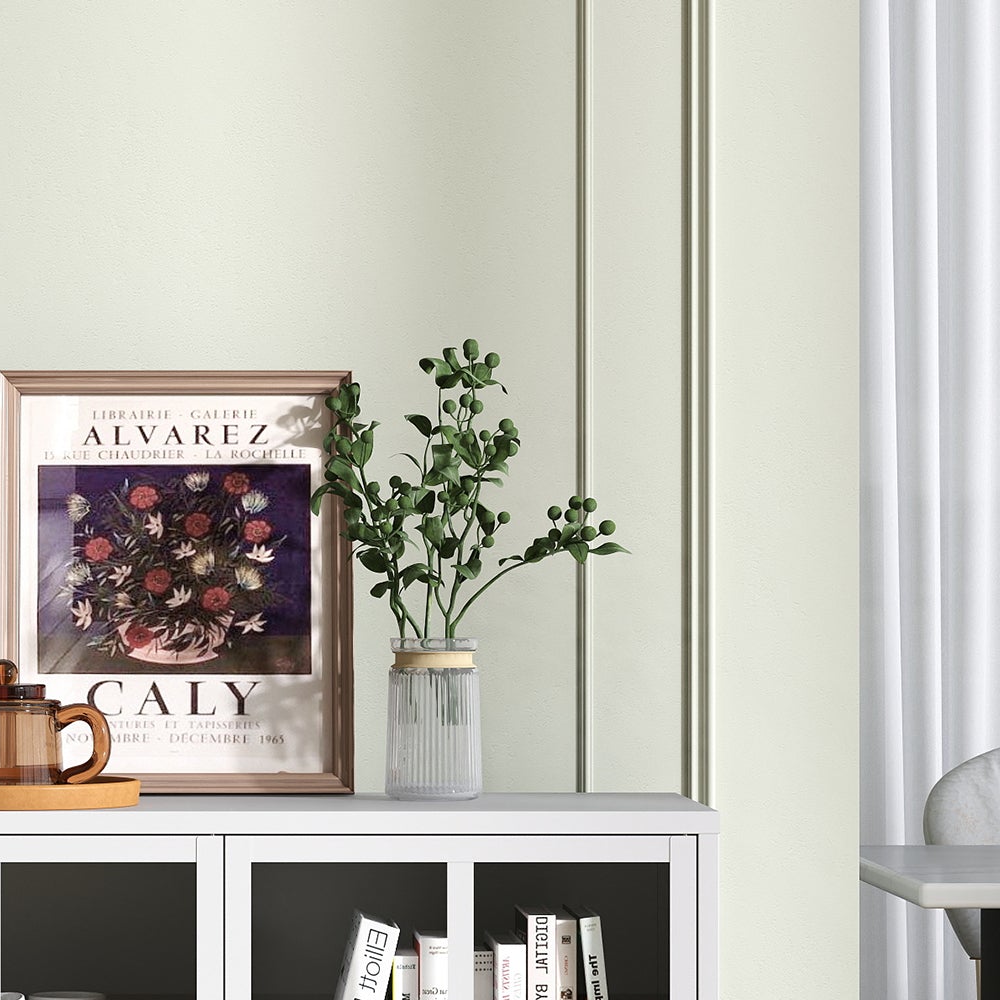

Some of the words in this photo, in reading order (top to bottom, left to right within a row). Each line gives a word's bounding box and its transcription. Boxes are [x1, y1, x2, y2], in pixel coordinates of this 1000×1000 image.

[92, 410, 172, 420] LIBRAIRIE
[191, 410, 258, 420] GALERIE
[82, 424, 269, 446] ALVAREZ
[63, 450, 91, 460] RUE
[98, 449, 184, 459] CHAUDRIER
[205, 449, 222, 459] LA
[231, 449, 306, 459] ROCHELLE
[87, 680, 262, 716] CALY
[164, 721, 178, 729] ET
[189, 721, 262, 730] TAPISSERIES
[66, 733, 150, 744] NOMBRE
[259, 735, 285, 745] 1965
